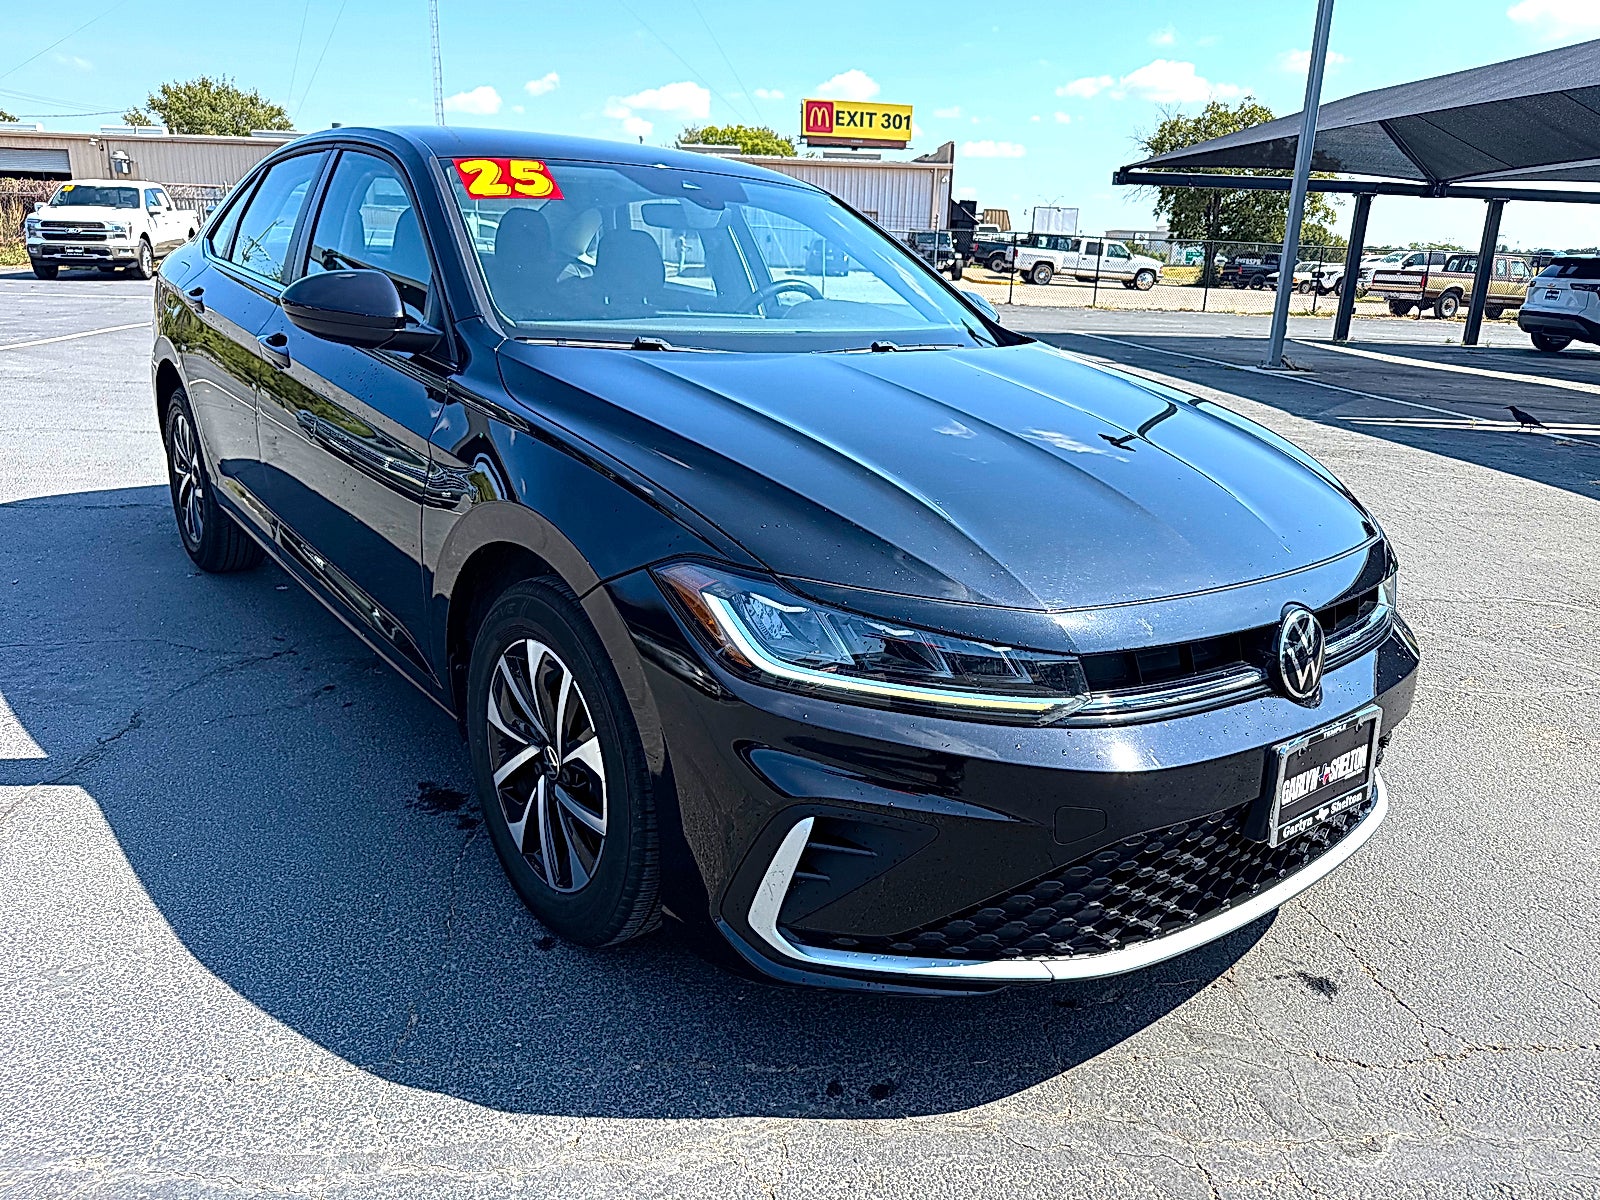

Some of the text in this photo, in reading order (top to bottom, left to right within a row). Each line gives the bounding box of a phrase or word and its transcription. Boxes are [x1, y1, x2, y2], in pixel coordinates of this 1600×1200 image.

[835, 109, 911, 130] EXIT 301
[459, 159, 554, 197] 25
[1281, 743, 1368, 806] GARLYN SHELTON
[1282, 792, 1363, 839] Garlyn Shelton
